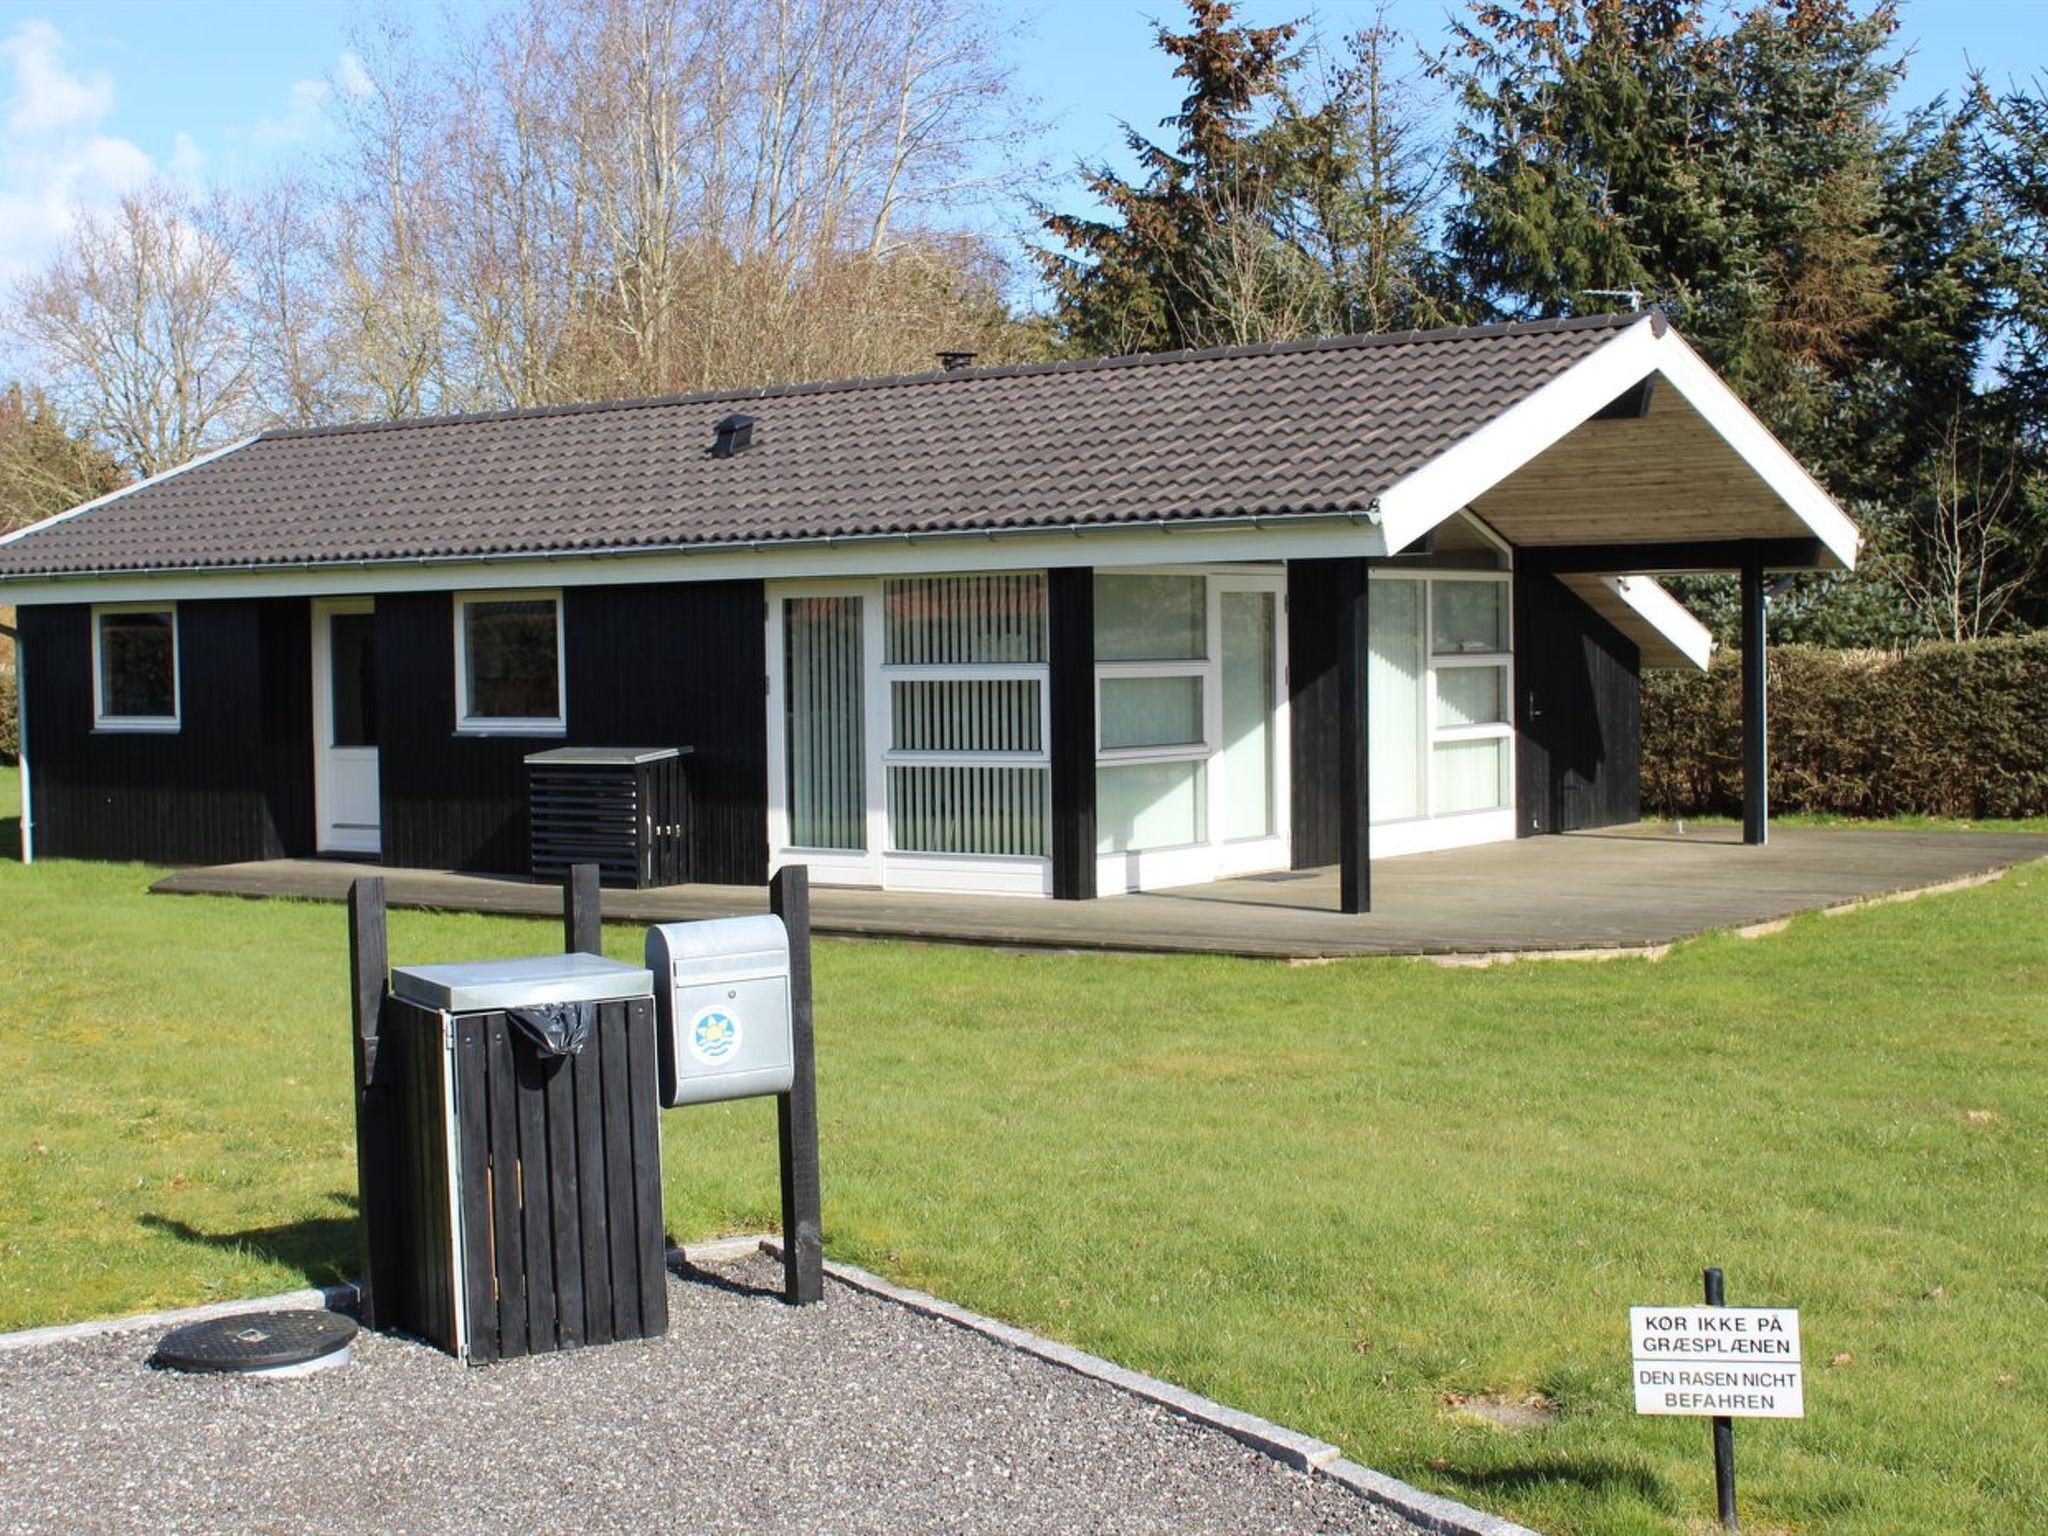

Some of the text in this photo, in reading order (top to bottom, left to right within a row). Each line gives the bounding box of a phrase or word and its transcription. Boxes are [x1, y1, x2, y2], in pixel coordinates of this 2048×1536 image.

[1698, 1317, 1747, 1332] IKKE
[1758, 1314, 1783, 1332] PÅ
[1643, 1337, 1790, 1354] GRÆSPLÆNEN
[1640, 1371, 1796, 1388] DEN RASEN NICHT
[1665, 1393, 1774, 1409] BEFAHREN
